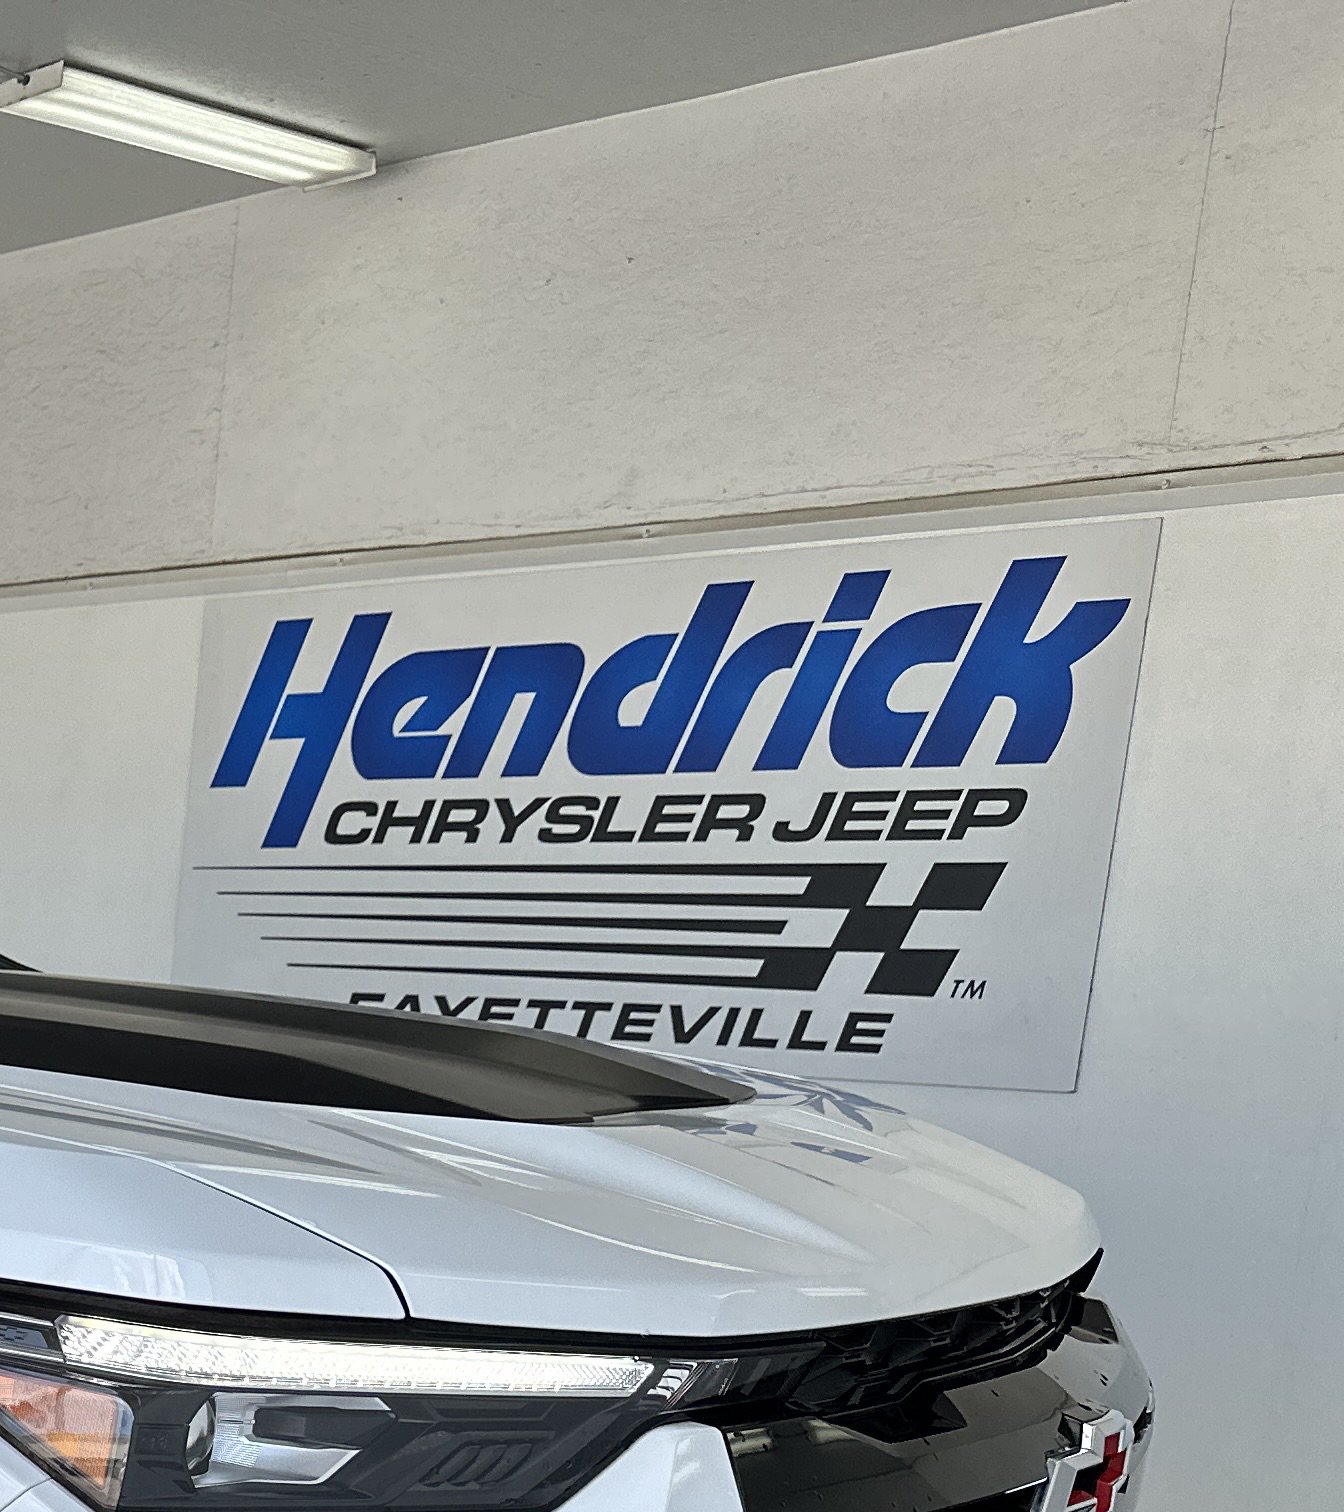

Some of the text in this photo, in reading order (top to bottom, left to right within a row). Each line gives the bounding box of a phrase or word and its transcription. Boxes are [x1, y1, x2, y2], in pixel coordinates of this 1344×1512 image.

[209, 555, 1131, 849] Hendrick
[322, 787, 1030, 847] CHRYSLER JEEP
[950, 979, 988, 1000] TM
